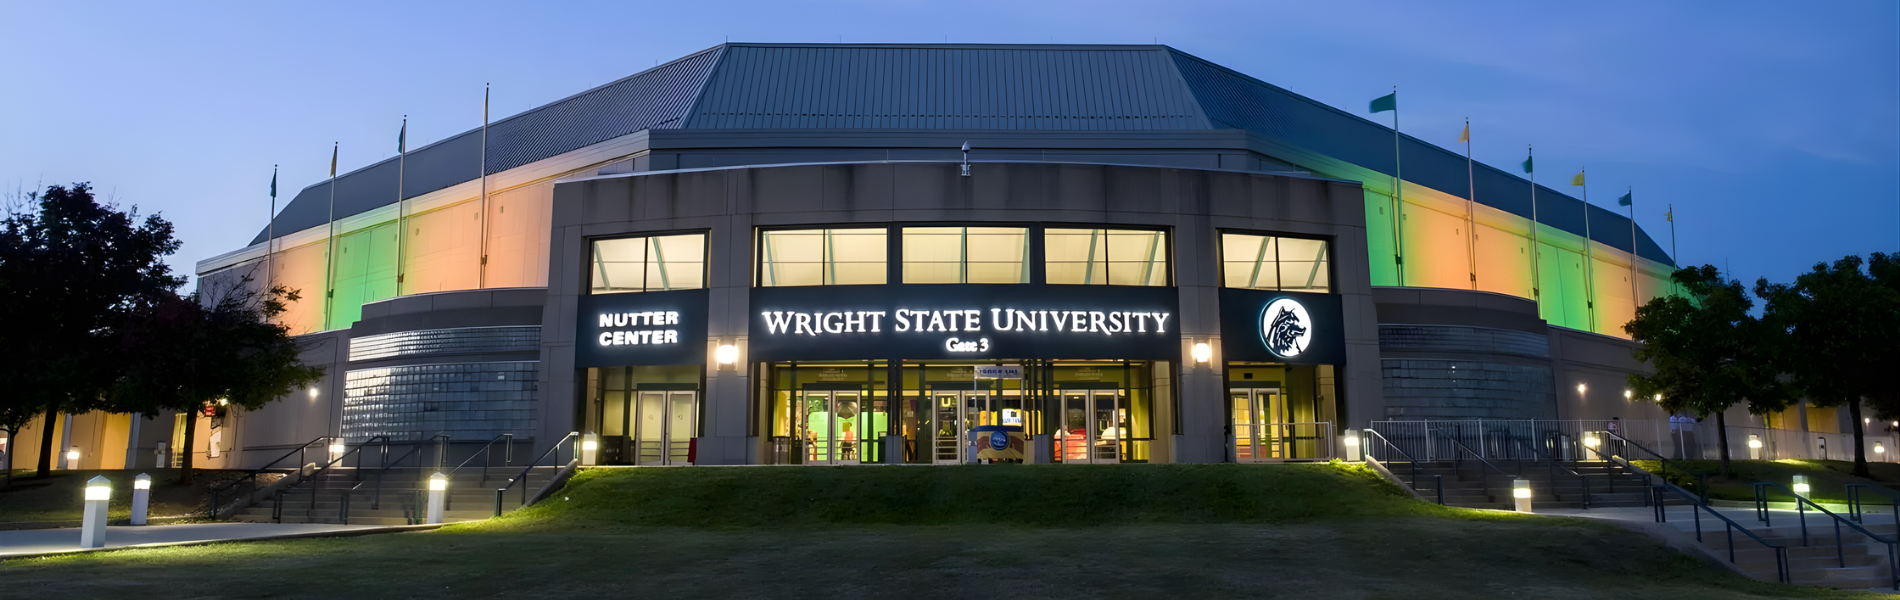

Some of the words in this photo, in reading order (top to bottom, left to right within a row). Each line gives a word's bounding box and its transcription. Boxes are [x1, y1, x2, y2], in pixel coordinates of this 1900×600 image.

[599, 311, 679, 327] NUTTER
[762, 311, 886, 336] WRIGHT
[895, 309, 981, 332] STATE
[991, 308, 1169, 335] UNIVERSITY
[599, 329, 678, 346] CENTER
[979, 337, 989, 352] 3
